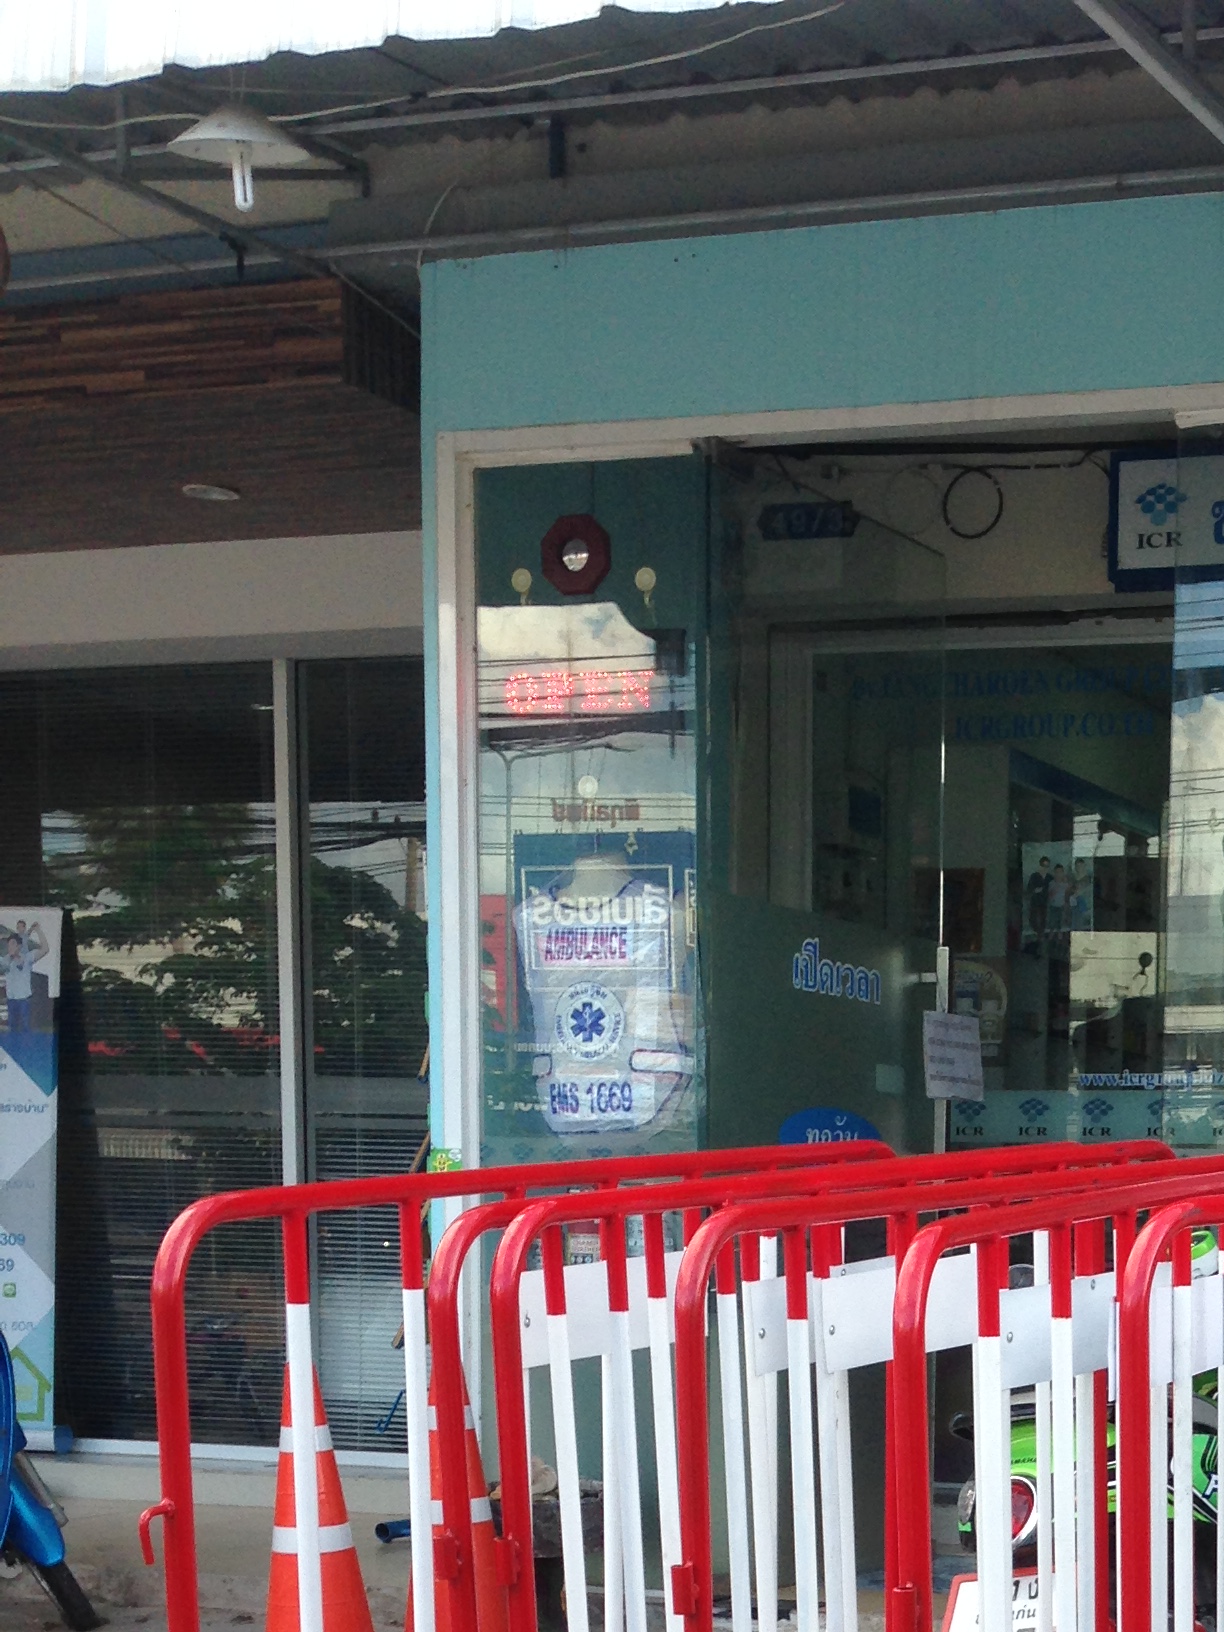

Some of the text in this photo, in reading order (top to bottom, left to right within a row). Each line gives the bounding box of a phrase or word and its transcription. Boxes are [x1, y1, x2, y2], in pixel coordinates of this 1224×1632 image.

[1136, 531, 1184, 550] ICR
[506, 670, 654, 713] OPEN
[792, 937, 882, 1006] เปิดเวลา
[550, 1082, 580, 1115] EMS
[588, 1079, 633, 1113] 1669
[955, 1126, 984, 1138] ICR
[1019, 1126, 1048, 1138] ICR
[1082, 1125, 1112, 1138] ICR
